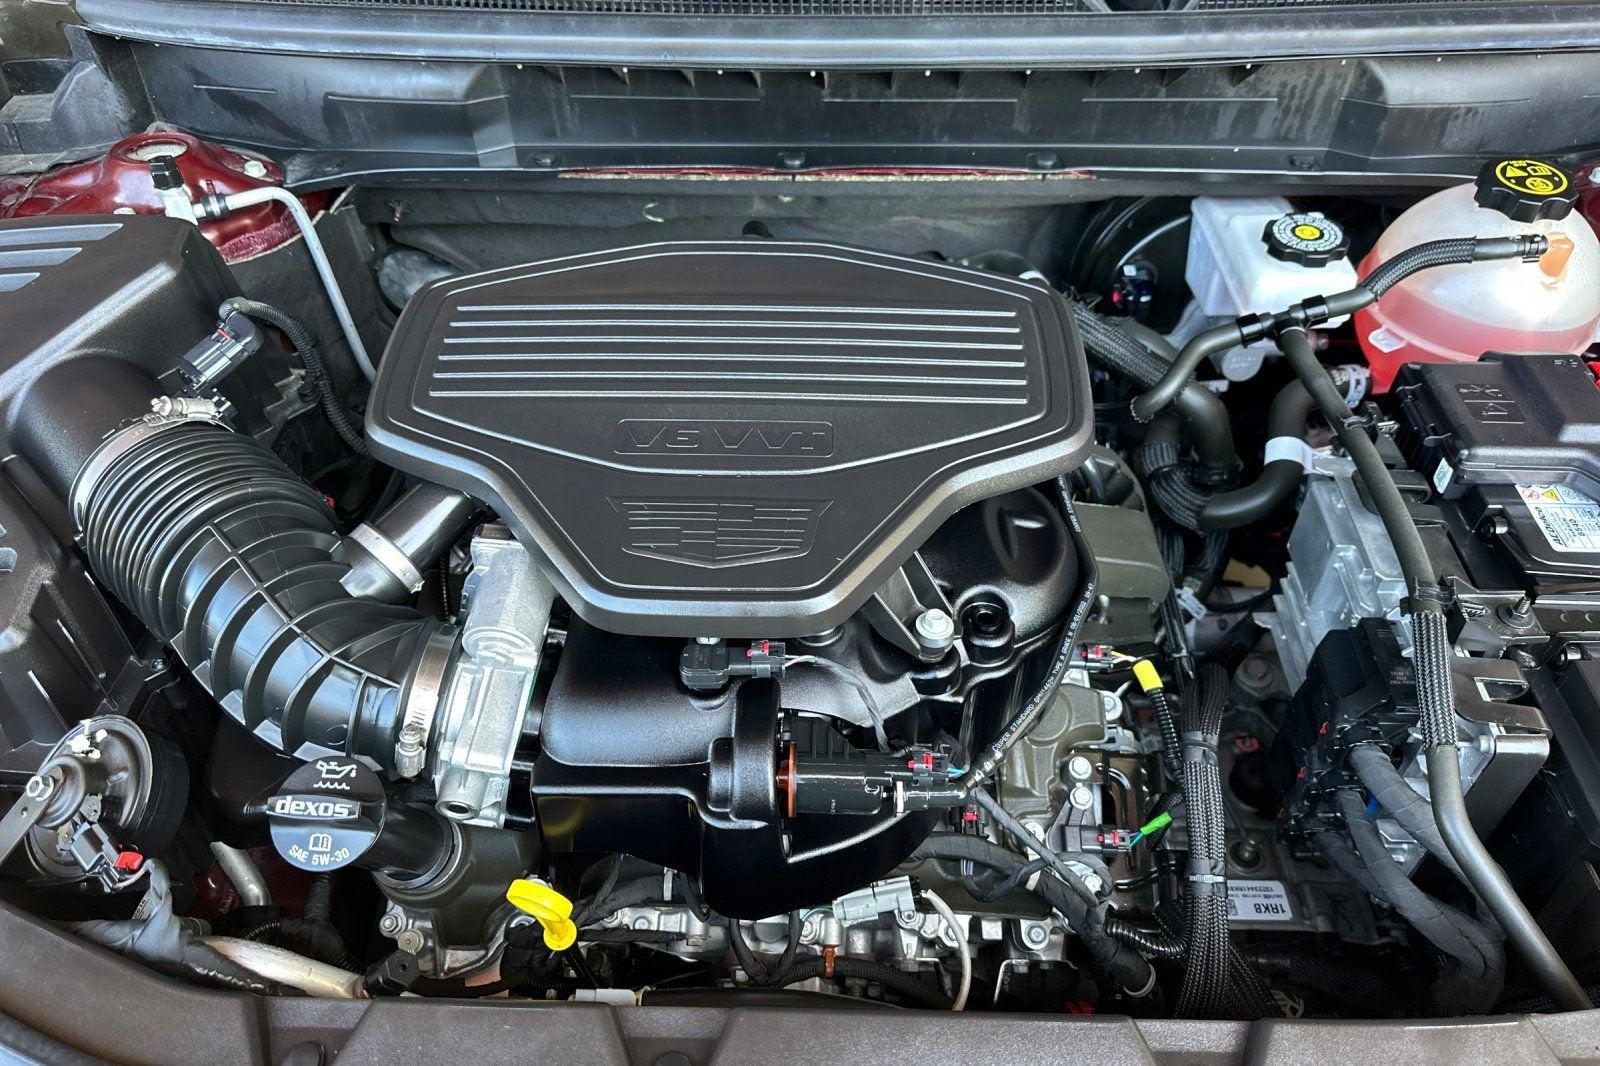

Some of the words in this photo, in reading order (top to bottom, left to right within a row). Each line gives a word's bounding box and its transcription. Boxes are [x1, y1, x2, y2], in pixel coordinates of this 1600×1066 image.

[626, 426, 700, 447] V6
[713, 427, 825, 449] VVT
[992, 732, 1010, 752] COOPER
[1010, 703, 1035, 731] STANDARD
[275, 796, 349, 818] dexos
[289, 845, 309, 862] SAE
[312, 848, 350, 866] 5W-30
[1253, 902, 1287, 914] 1RKB
